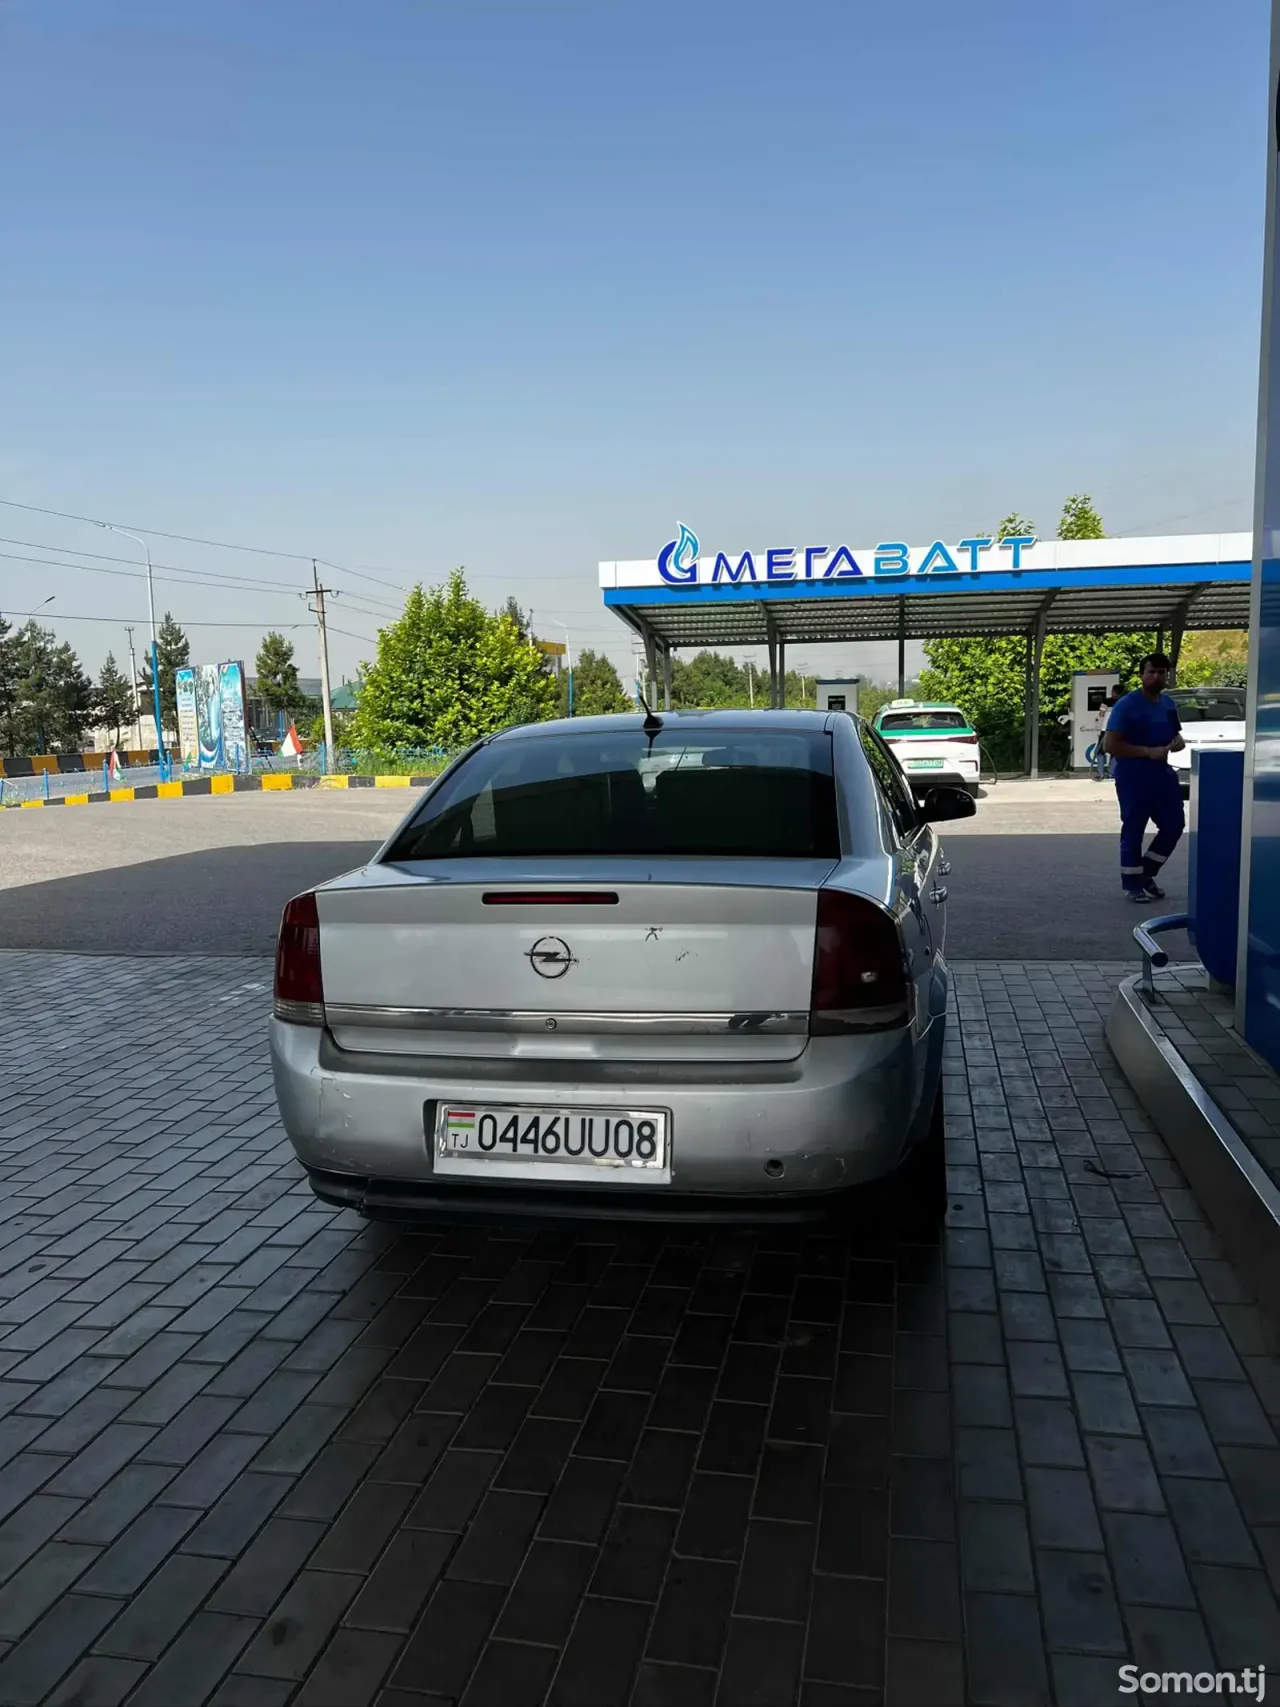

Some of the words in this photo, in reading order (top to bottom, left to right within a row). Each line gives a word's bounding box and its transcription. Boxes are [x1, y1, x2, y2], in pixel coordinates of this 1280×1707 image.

[712, 536, 1035, 581] МЕГАВАТТ
[452, 1133, 468, 1148] TJ
[478, 1114, 656, 1159] 0446UU08
